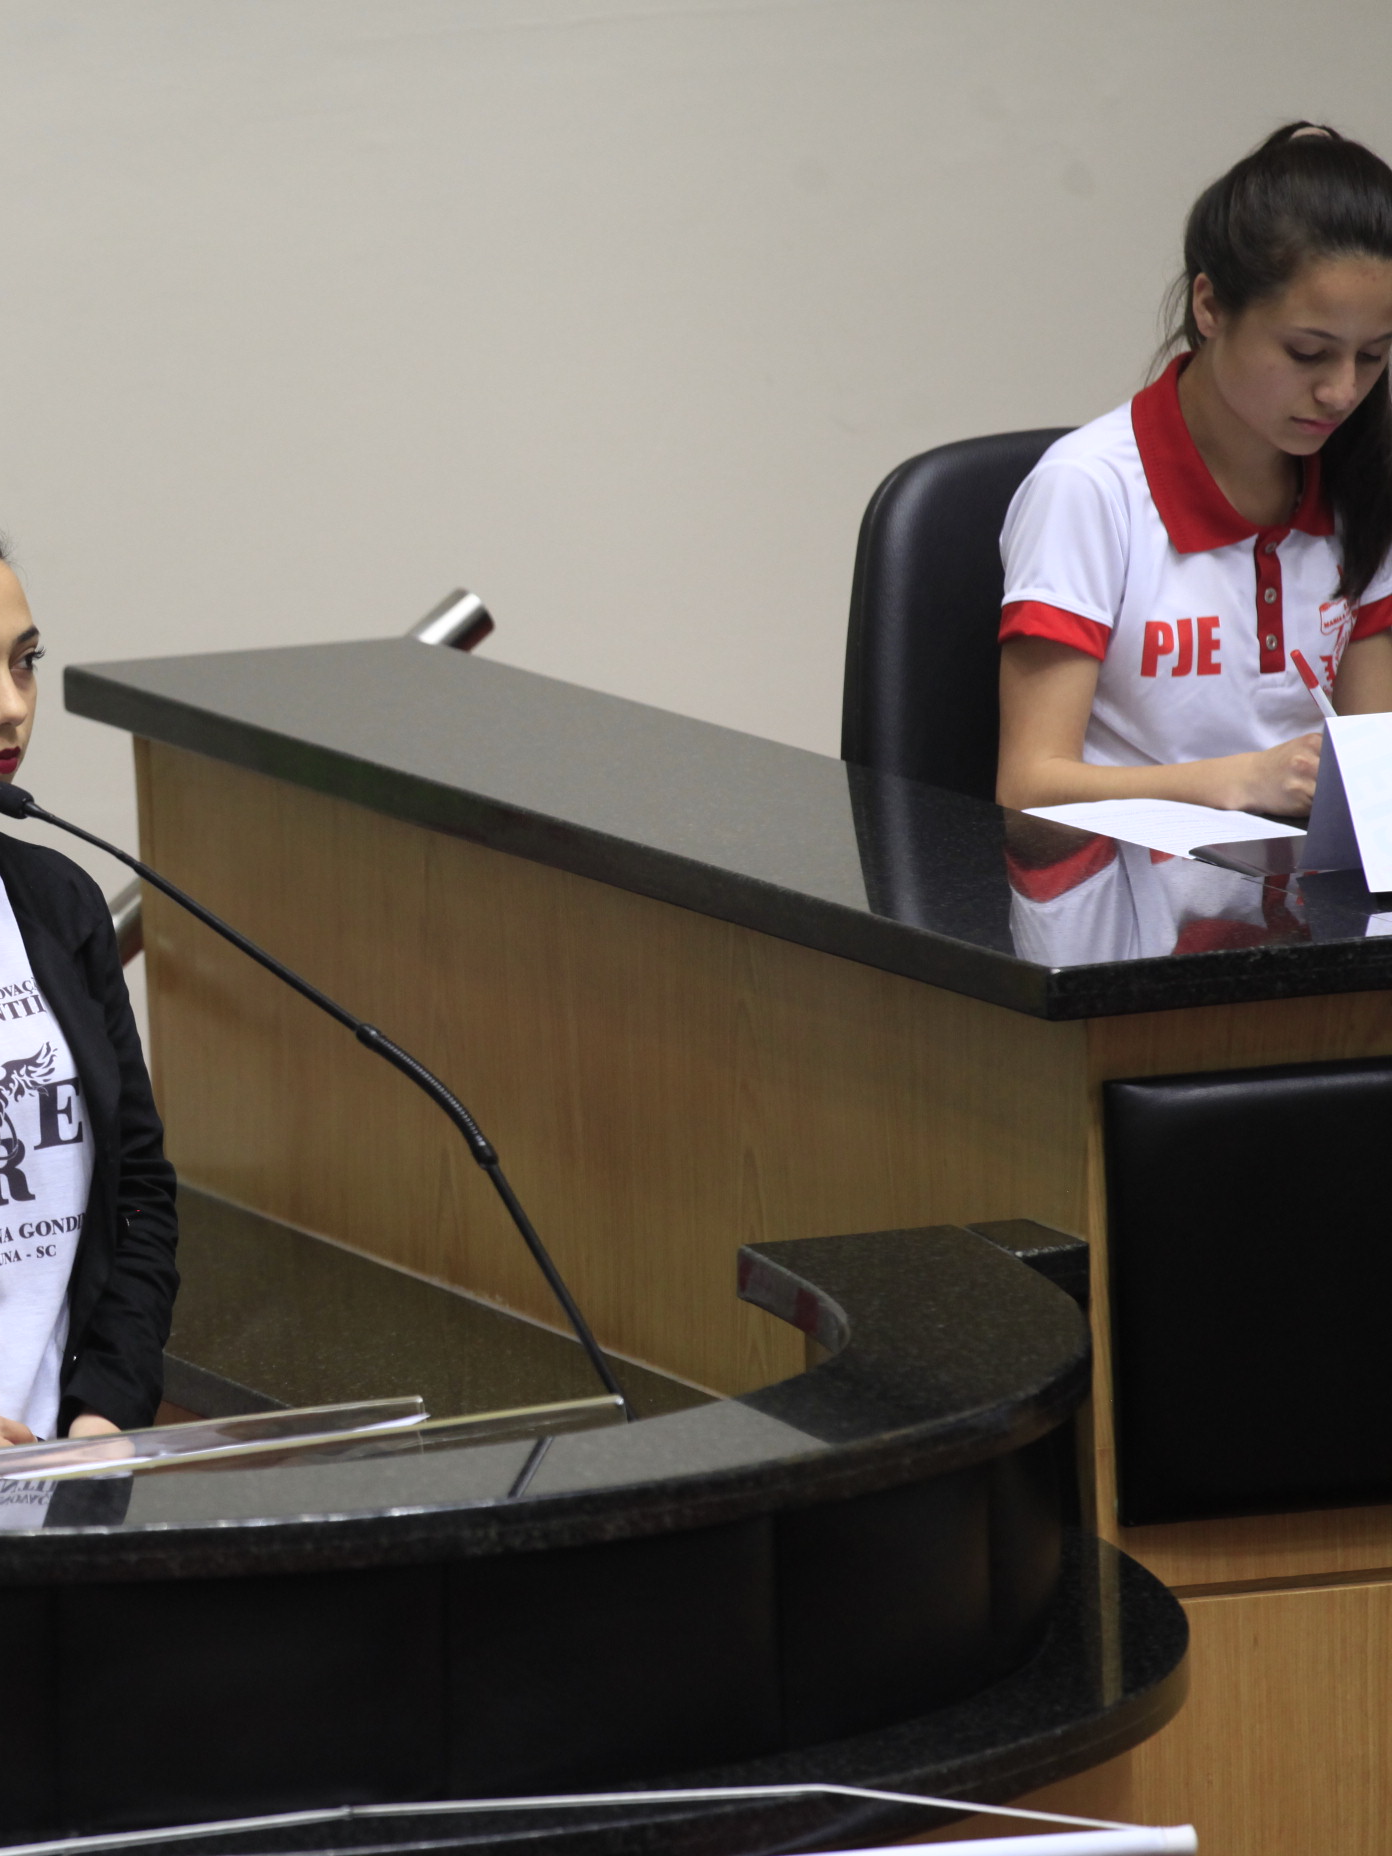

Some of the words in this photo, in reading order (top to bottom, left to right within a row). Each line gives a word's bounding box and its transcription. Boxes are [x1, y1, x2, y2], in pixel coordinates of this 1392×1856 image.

[1140, 615, 1222, 678] PJE
[18, 1212, 87, 1239] GONDI
[36, 1244, 57, 1259] SC
